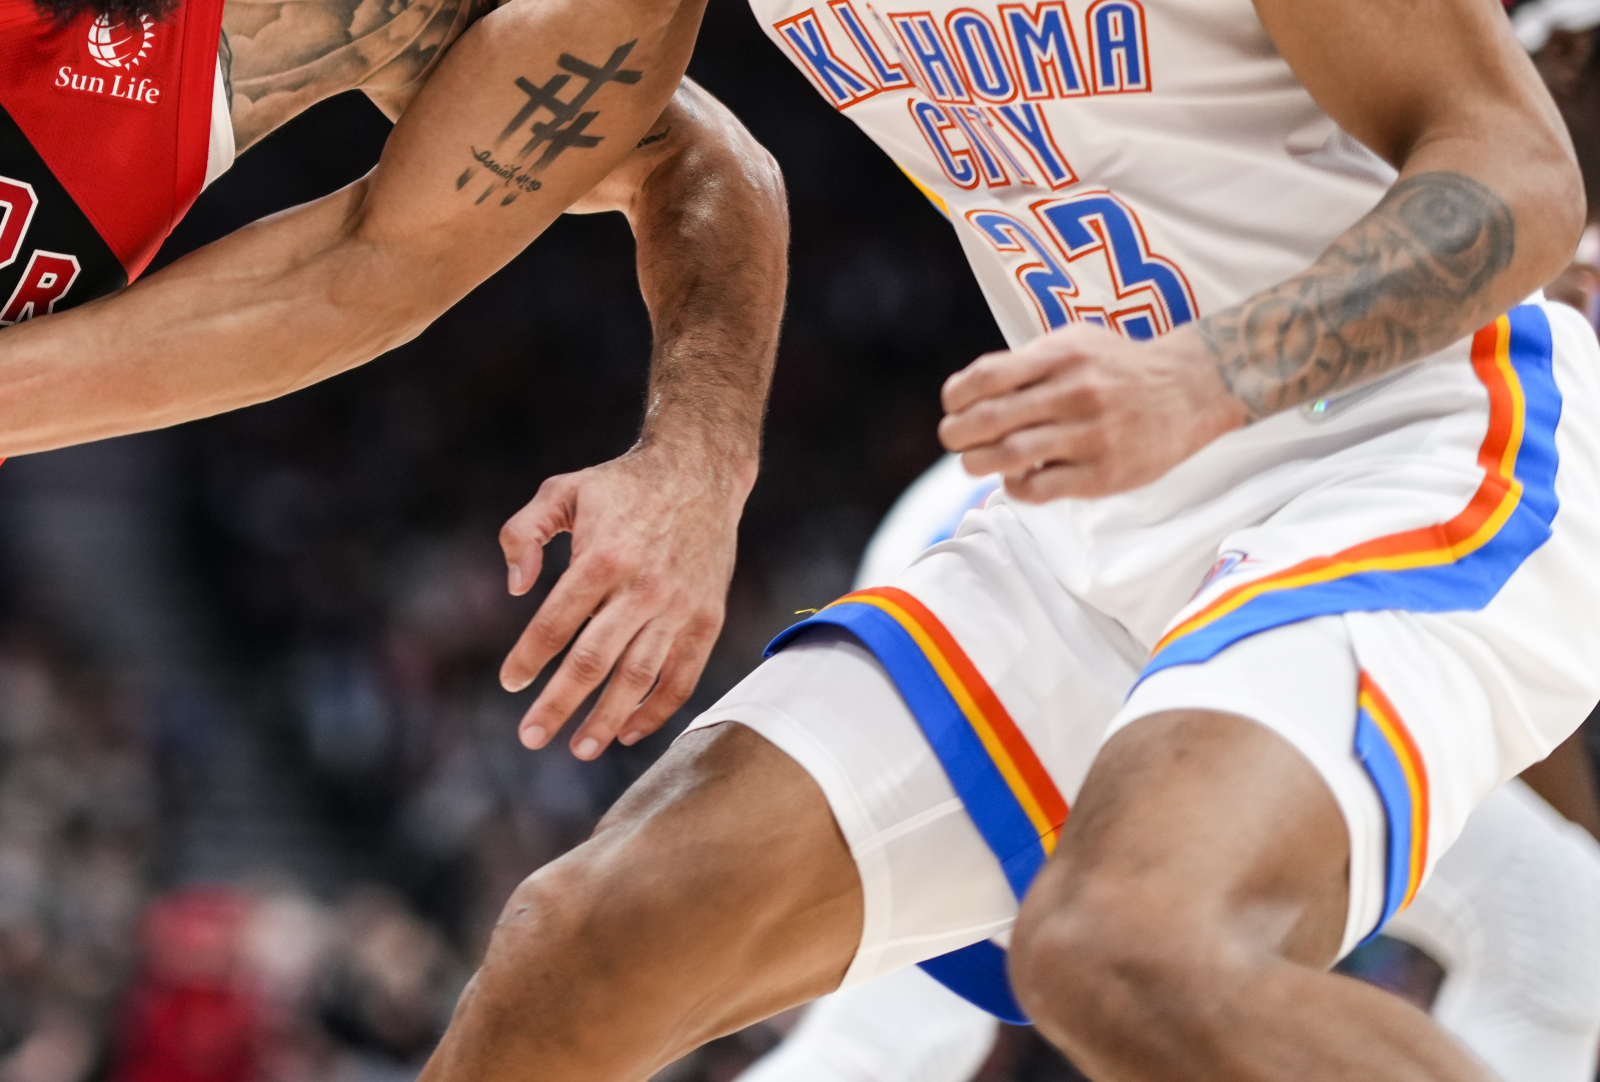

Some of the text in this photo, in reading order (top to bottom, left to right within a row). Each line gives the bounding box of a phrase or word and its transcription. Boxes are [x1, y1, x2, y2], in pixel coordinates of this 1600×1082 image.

[55, 65, 160, 104] Sun Life
[964, 190, 1201, 343] 23
